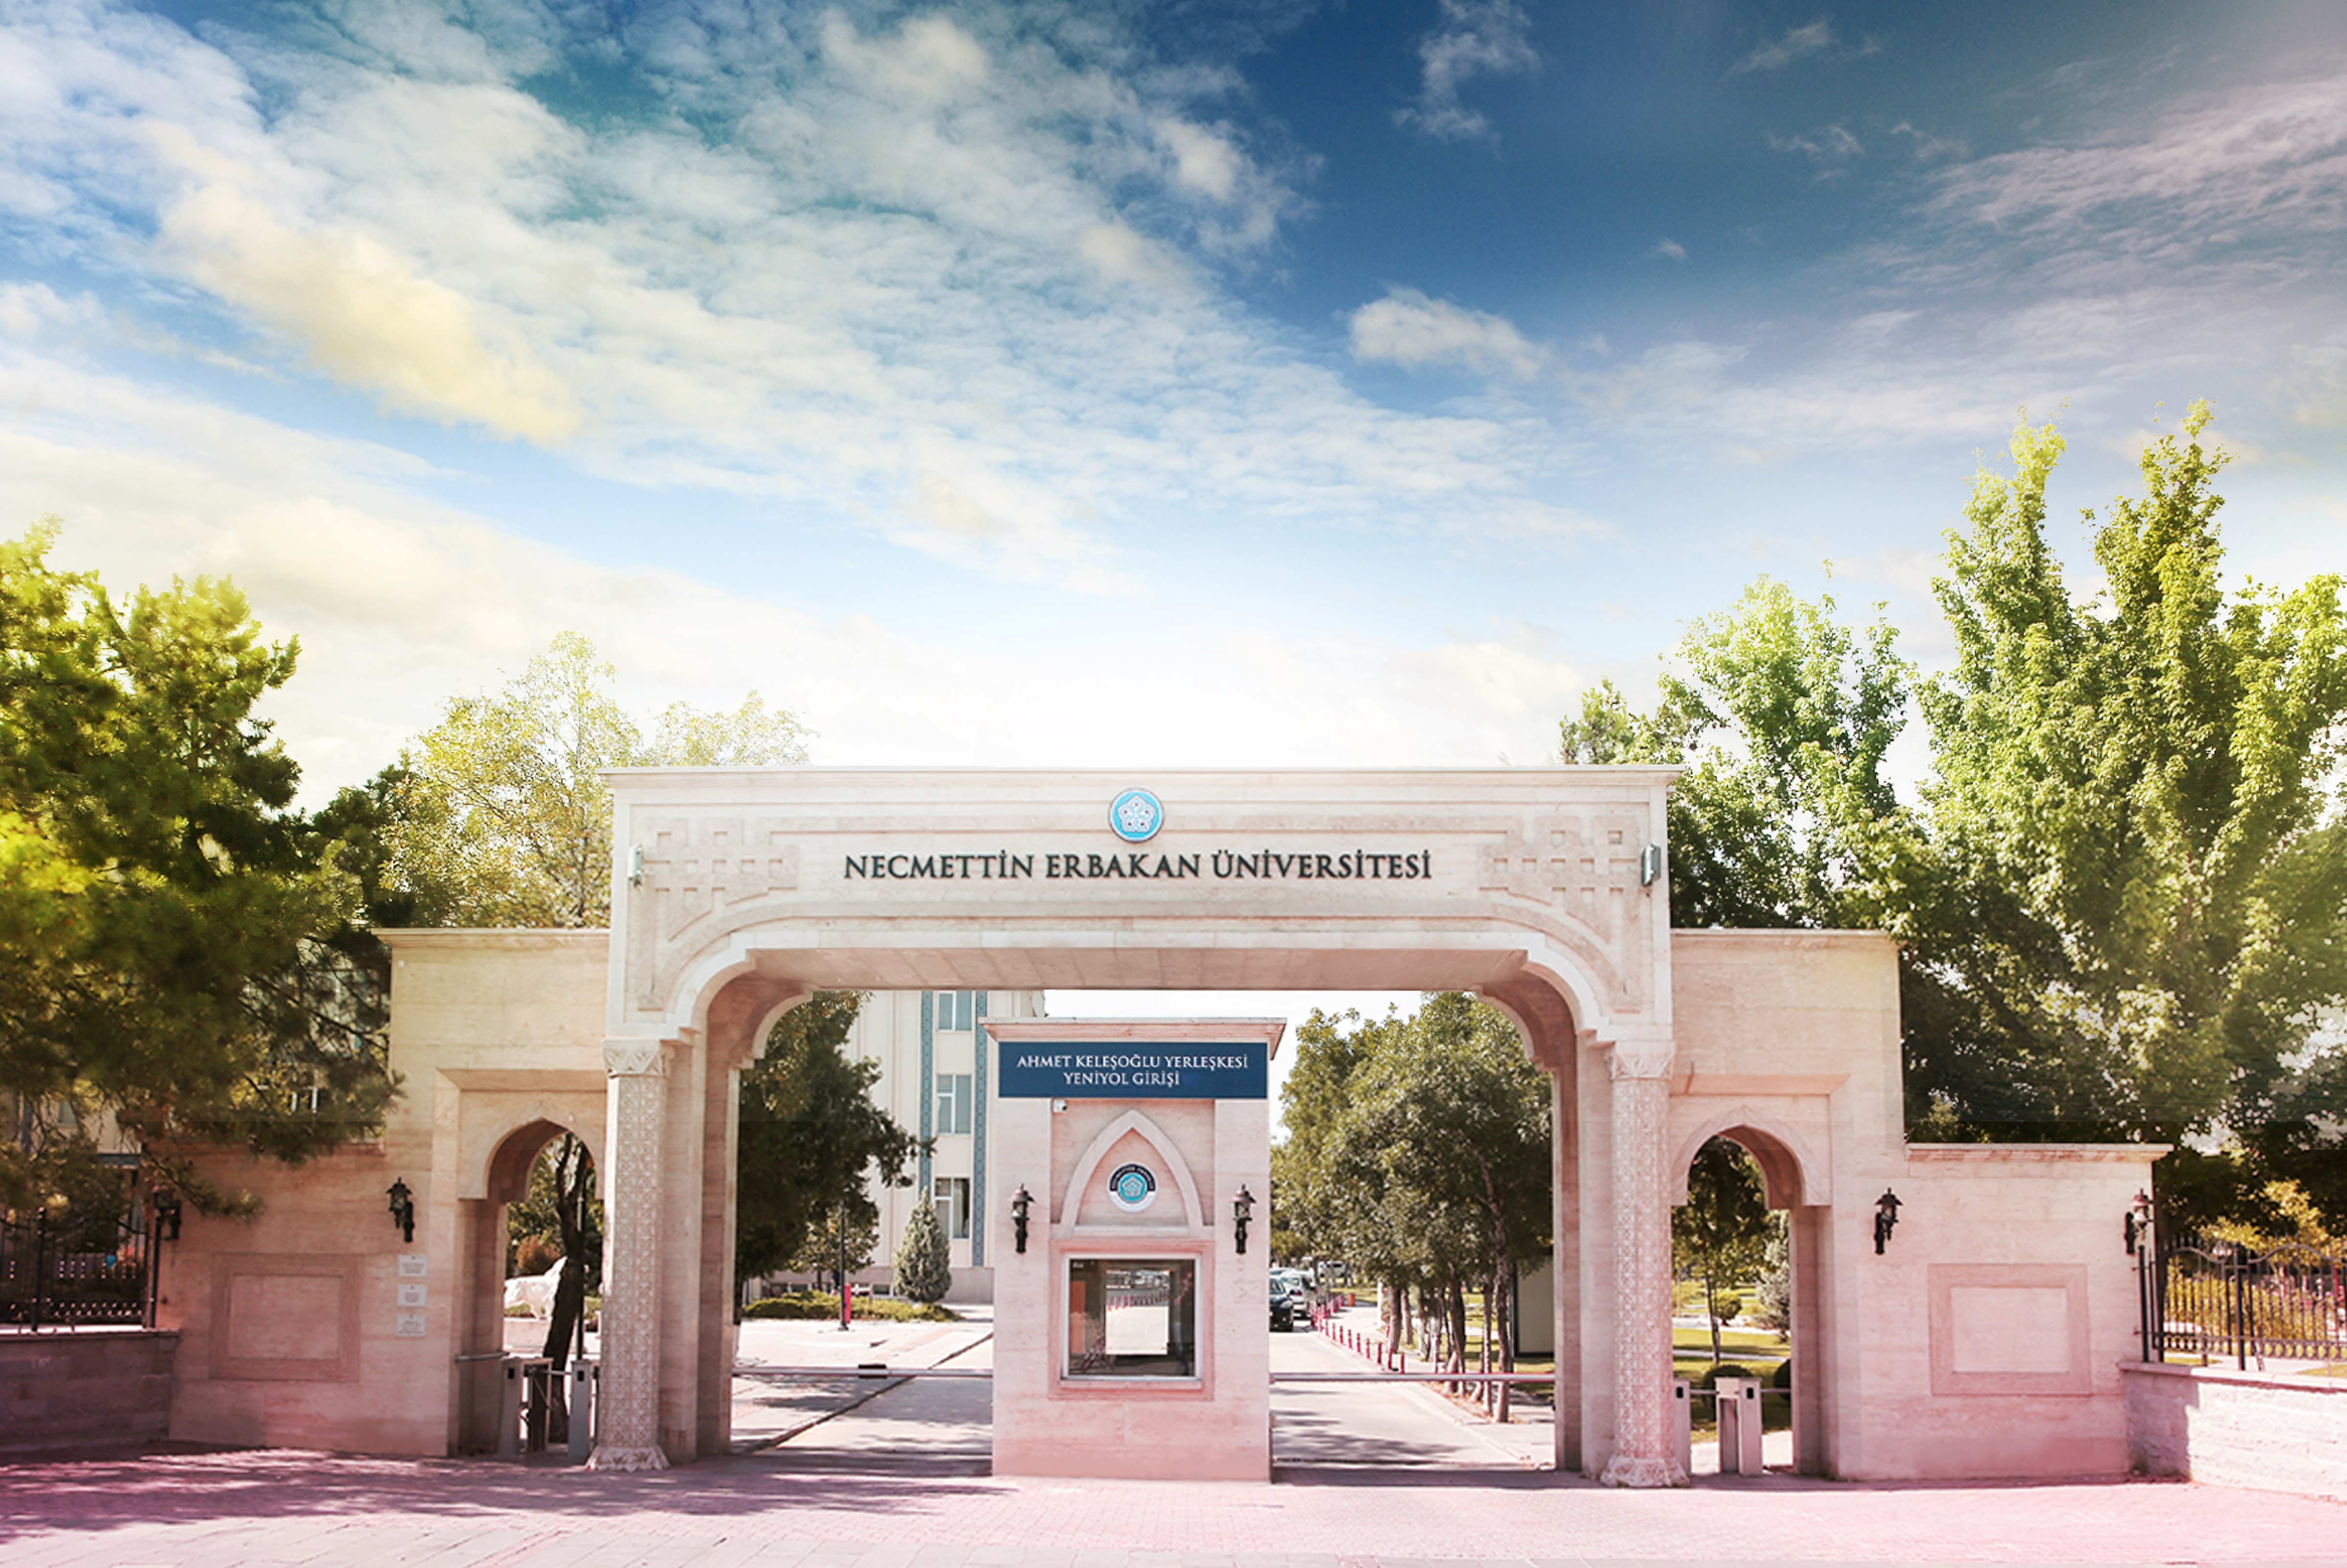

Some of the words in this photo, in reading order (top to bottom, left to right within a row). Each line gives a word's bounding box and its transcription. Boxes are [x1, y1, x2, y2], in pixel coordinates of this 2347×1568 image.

[844, 850, 1033, 878] NECMETTİN
[1046, 853, 1201, 878] ERBAKAN
[1210, 850, 1431, 878] ÜNİVERSİTESİ
[1016, 1055, 1072, 1068] AHMET
[1075, 1053, 1161, 1071] KELEŞOĞLU
[1164, 1053, 1248, 1071] YERLEŞKESİ
[1063, 1070, 1129, 1085] YENİYOL
[1132, 1070, 1180, 1088] GİRİŞİ
